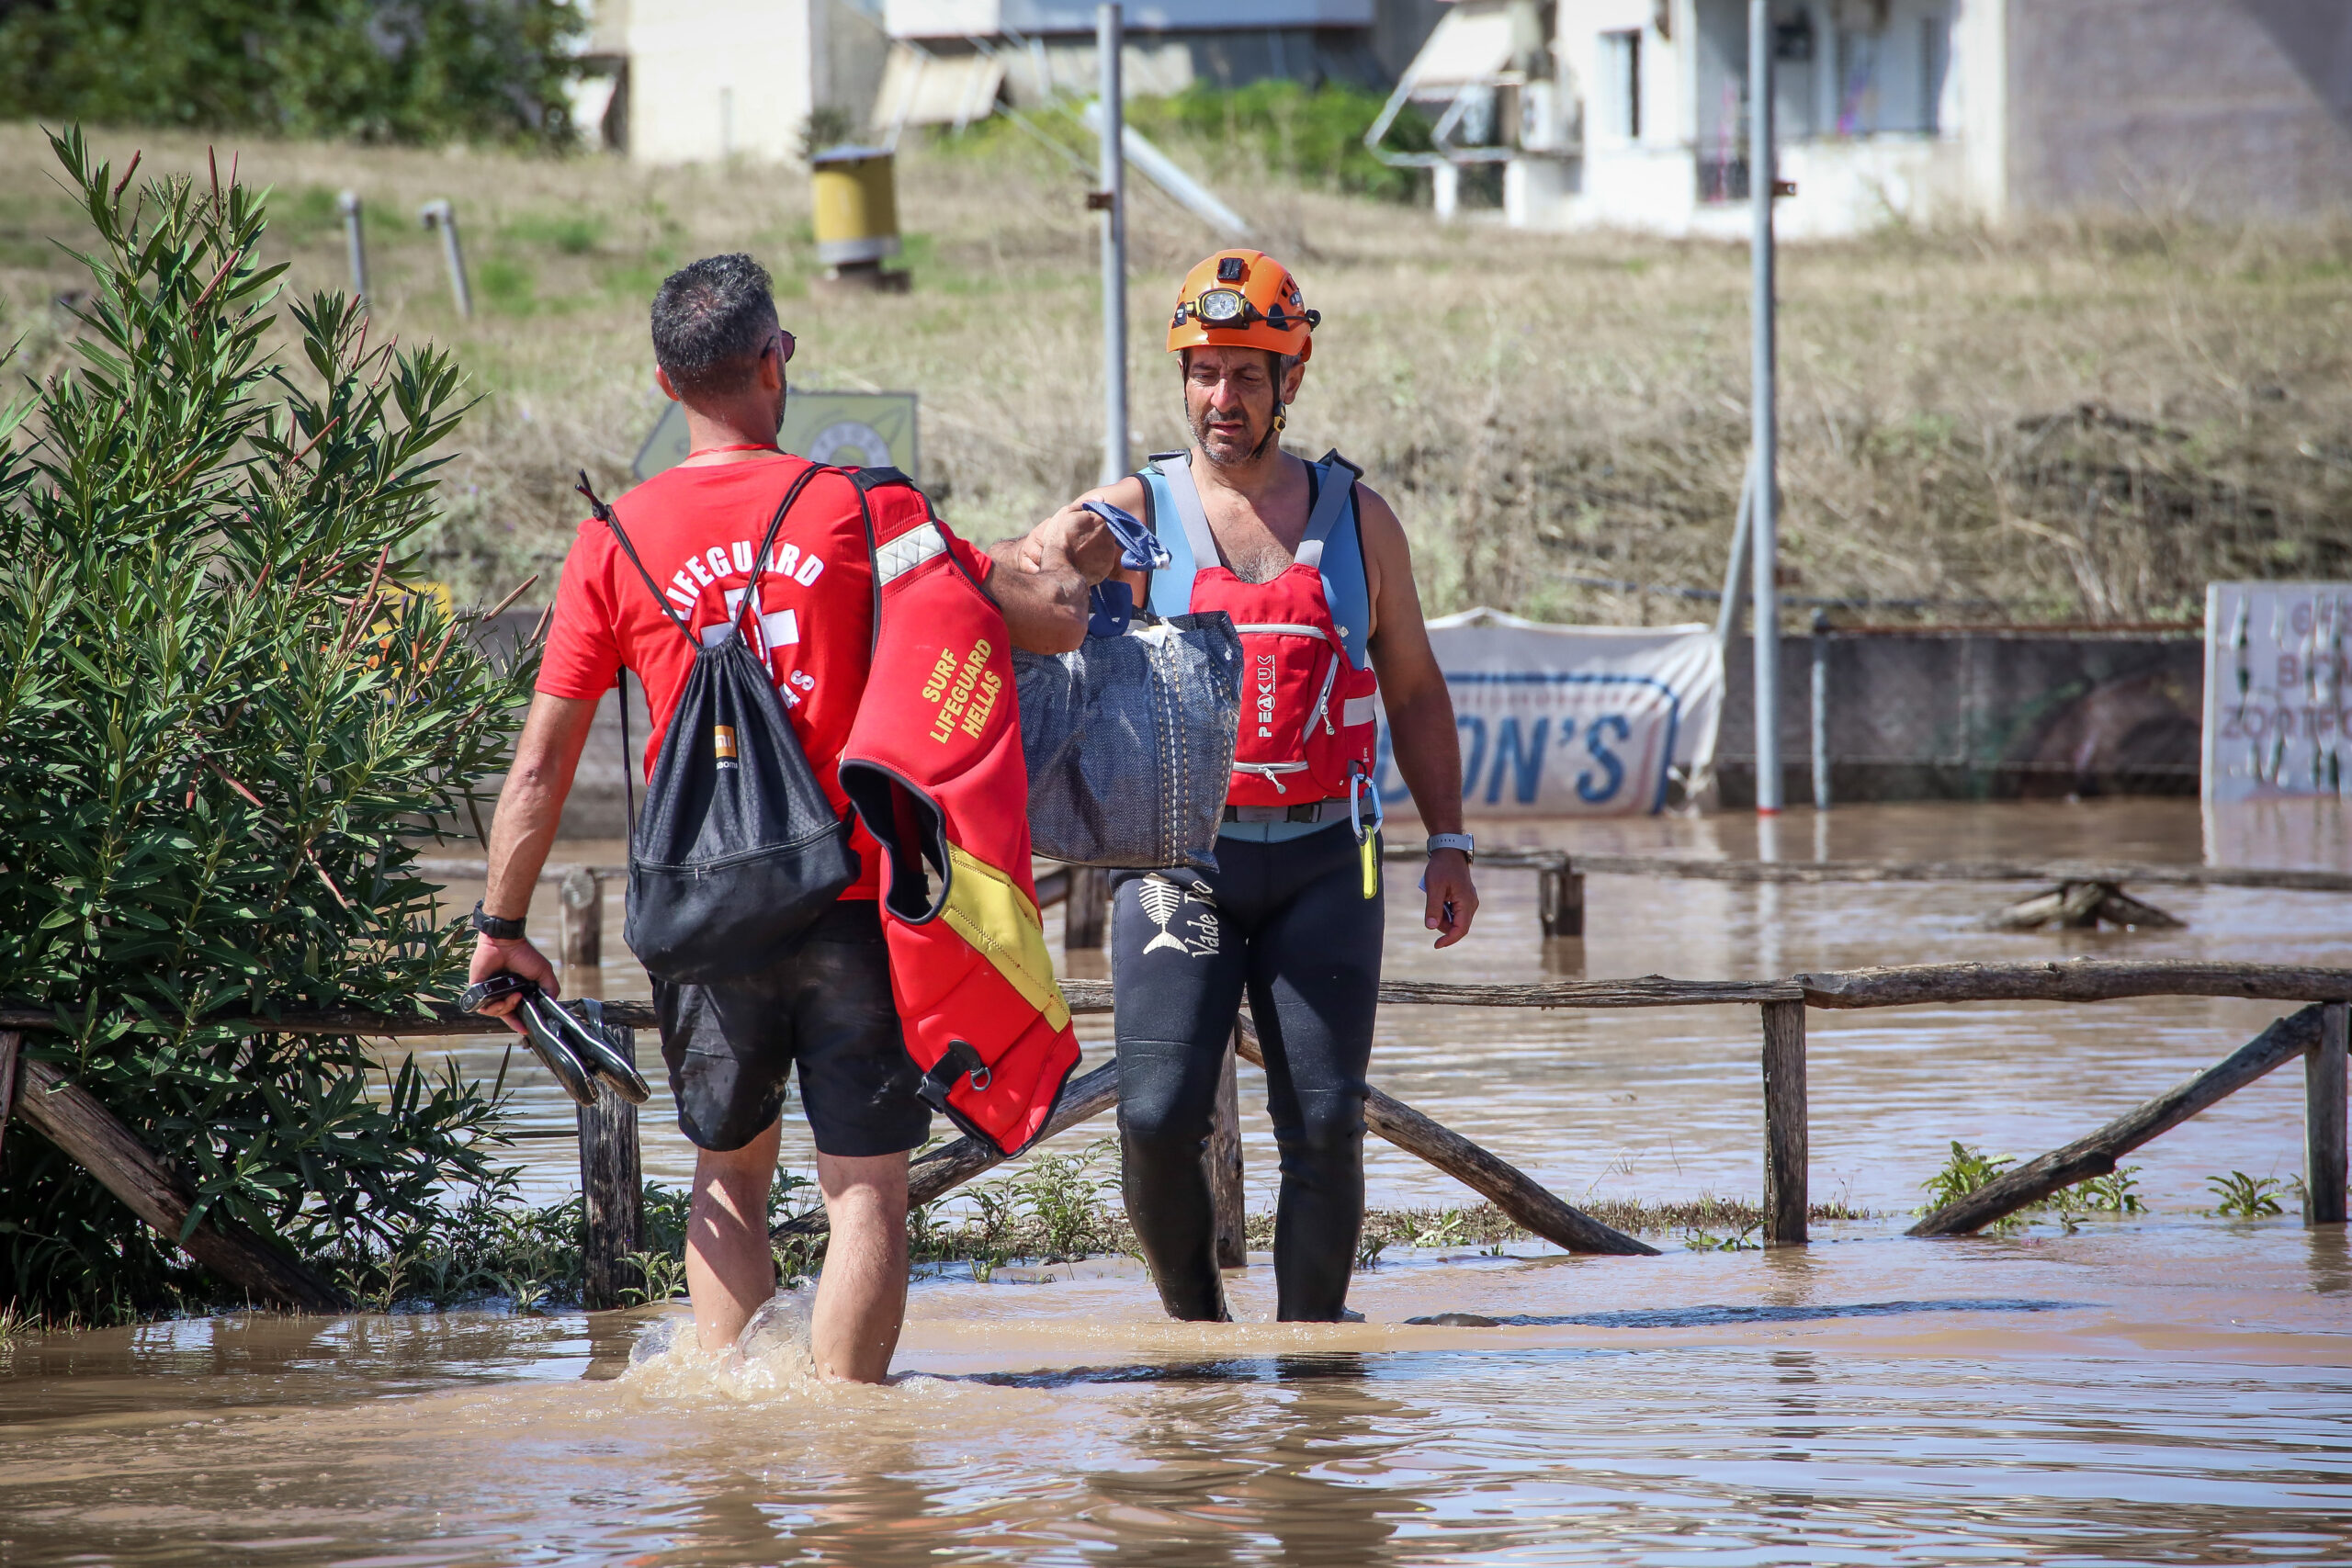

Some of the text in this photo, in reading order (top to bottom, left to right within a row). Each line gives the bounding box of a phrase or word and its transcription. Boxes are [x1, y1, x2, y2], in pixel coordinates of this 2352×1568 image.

[922, 648, 957, 703] SURF
[929, 638, 991, 744] LIFEGUARD
[960, 670, 1002, 739] HELLAS
[1184, 913, 1219, 958] Vade
